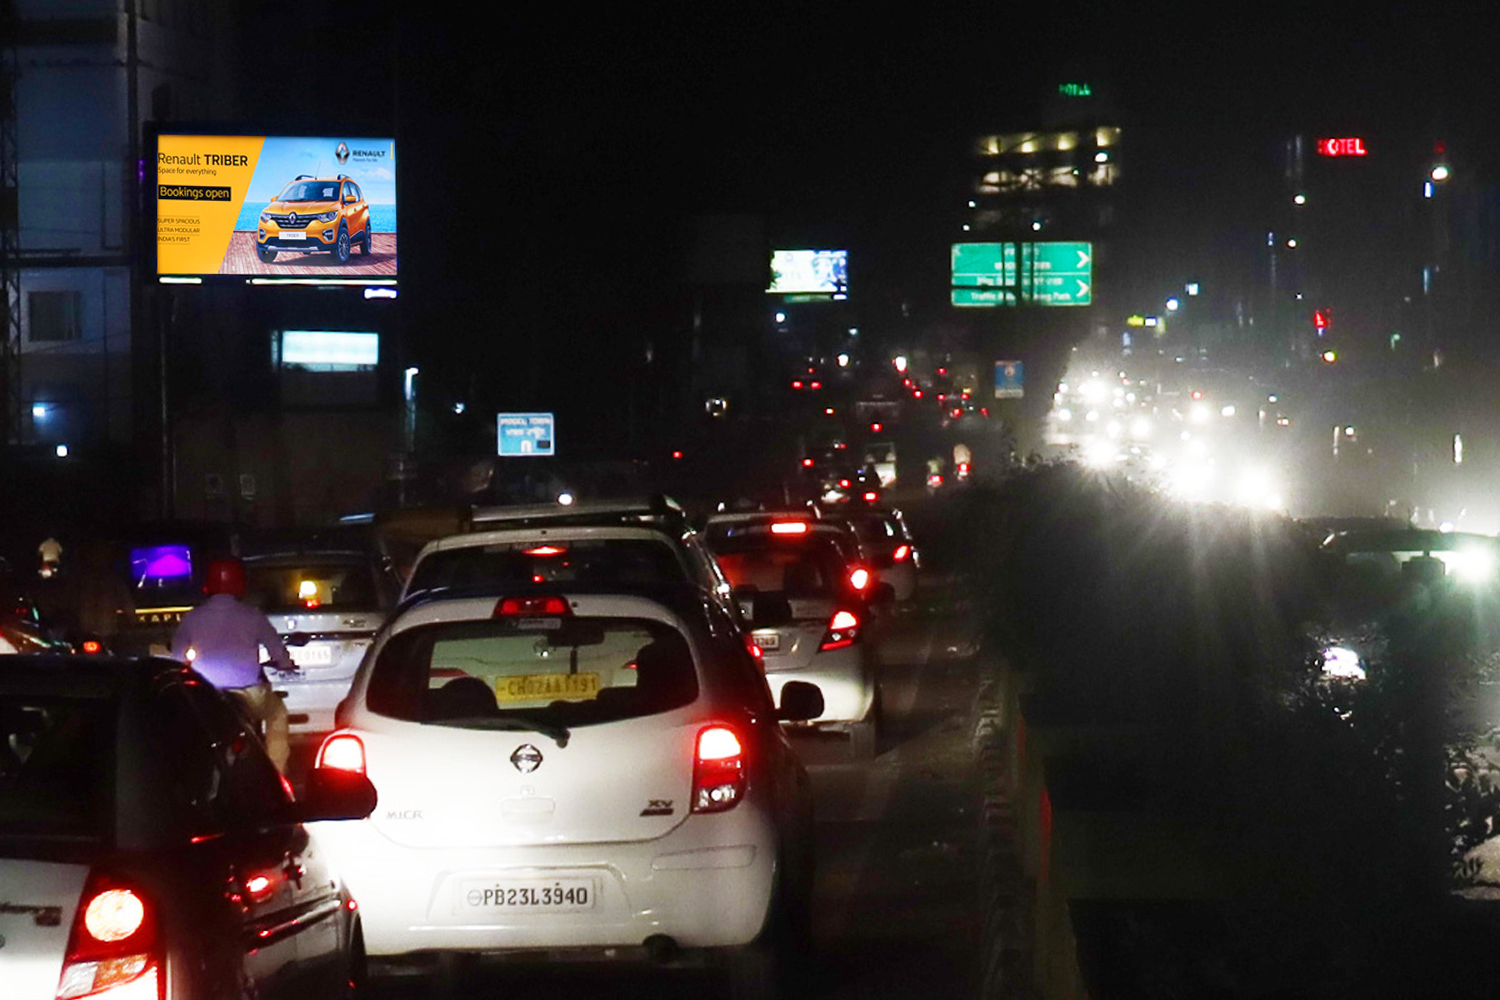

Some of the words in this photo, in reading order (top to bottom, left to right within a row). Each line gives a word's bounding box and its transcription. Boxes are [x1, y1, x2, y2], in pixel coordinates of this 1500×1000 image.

[158, 152, 201, 165] Renault
[204, 154, 248, 166] TRIBER
[158, 166, 176, 174] Space
[186, 168, 217, 176] everything
[160, 186, 203, 200] Bookings
[205, 189, 229, 200] open
[387, 810, 424, 820] MICR
[484, 887, 588, 906] PB23L3940
